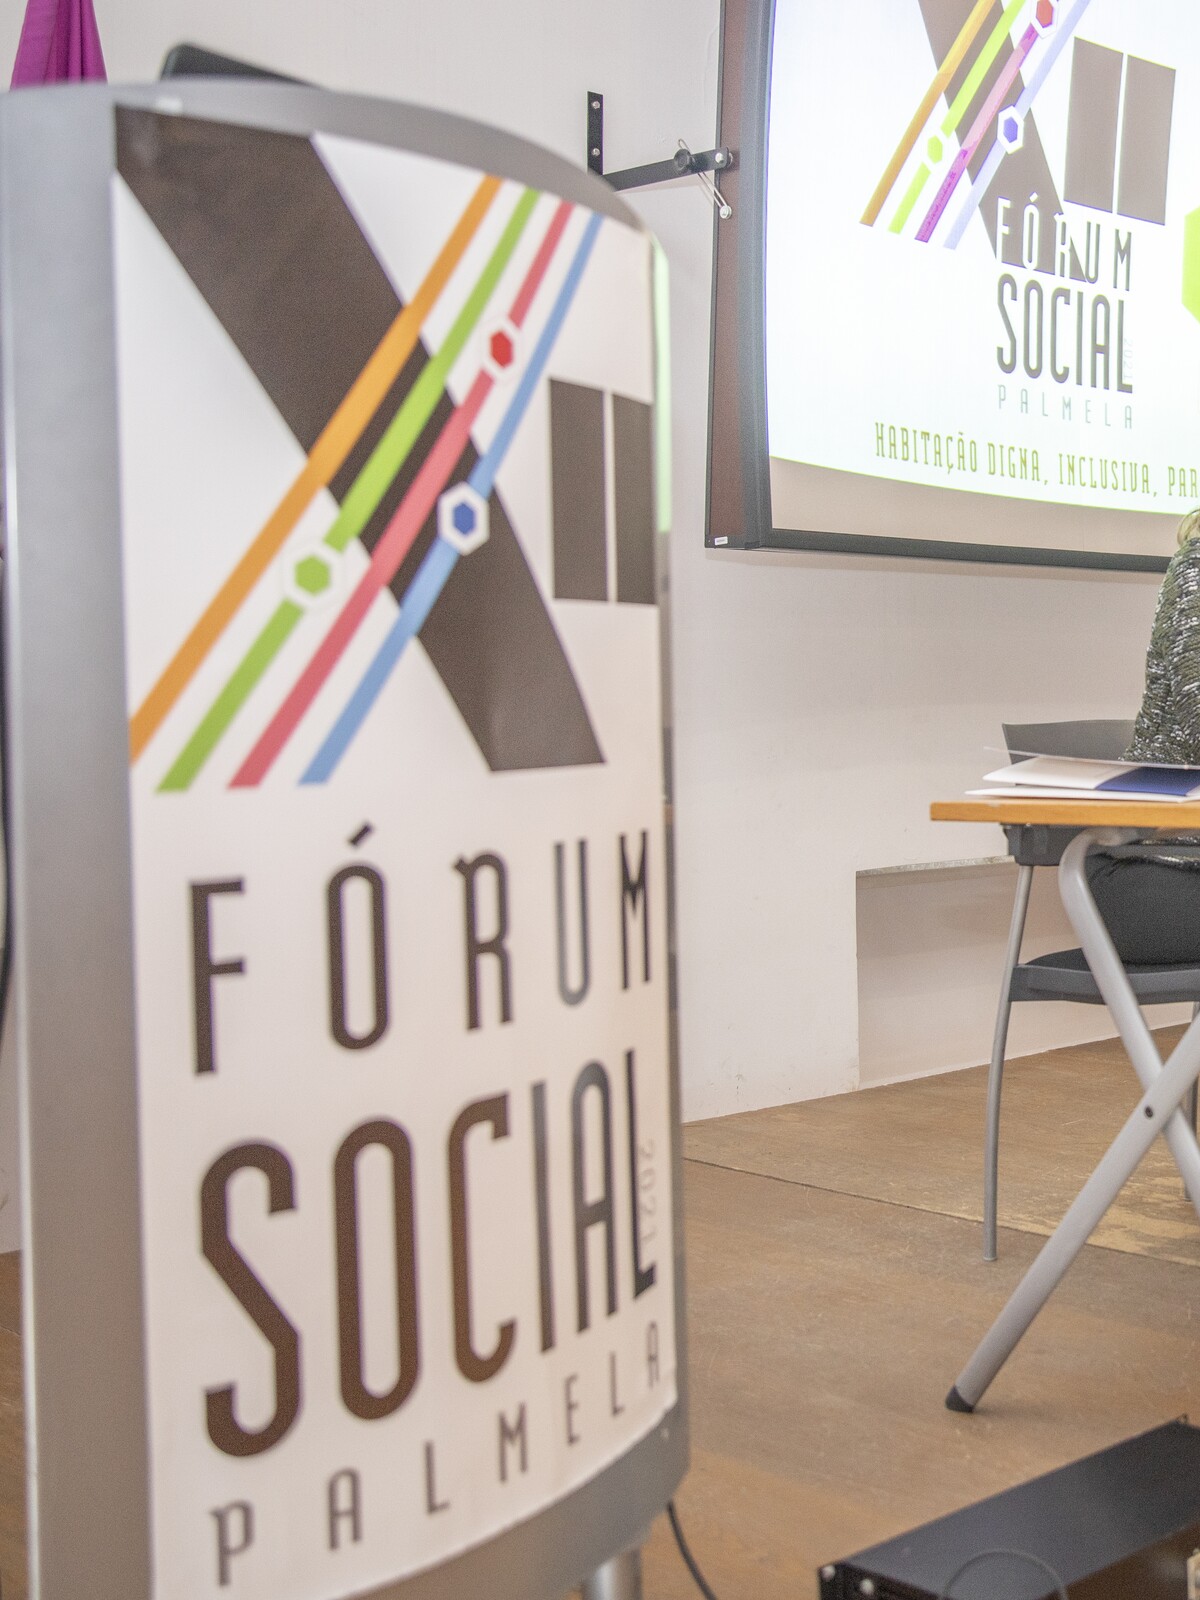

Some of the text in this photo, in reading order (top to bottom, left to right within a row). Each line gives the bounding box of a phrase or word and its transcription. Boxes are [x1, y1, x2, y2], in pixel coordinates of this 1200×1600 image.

[997, 192, 1132, 292] FÓRUM
[996, 273, 1134, 394] SOCIAL
[874, 421, 978, 475] HABITAÇÃO
[987, 442, 1049, 485] DIGNA,
[1059, 453, 1158, 497] INCLUSIVA,
[997, 384, 1133, 430] PALMELA
[187, 821, 653, 1077] FÓRUM
[200, 1048, 658, 1458] SOCIAL
[210, 1321, 661, 1587] PALMELA
